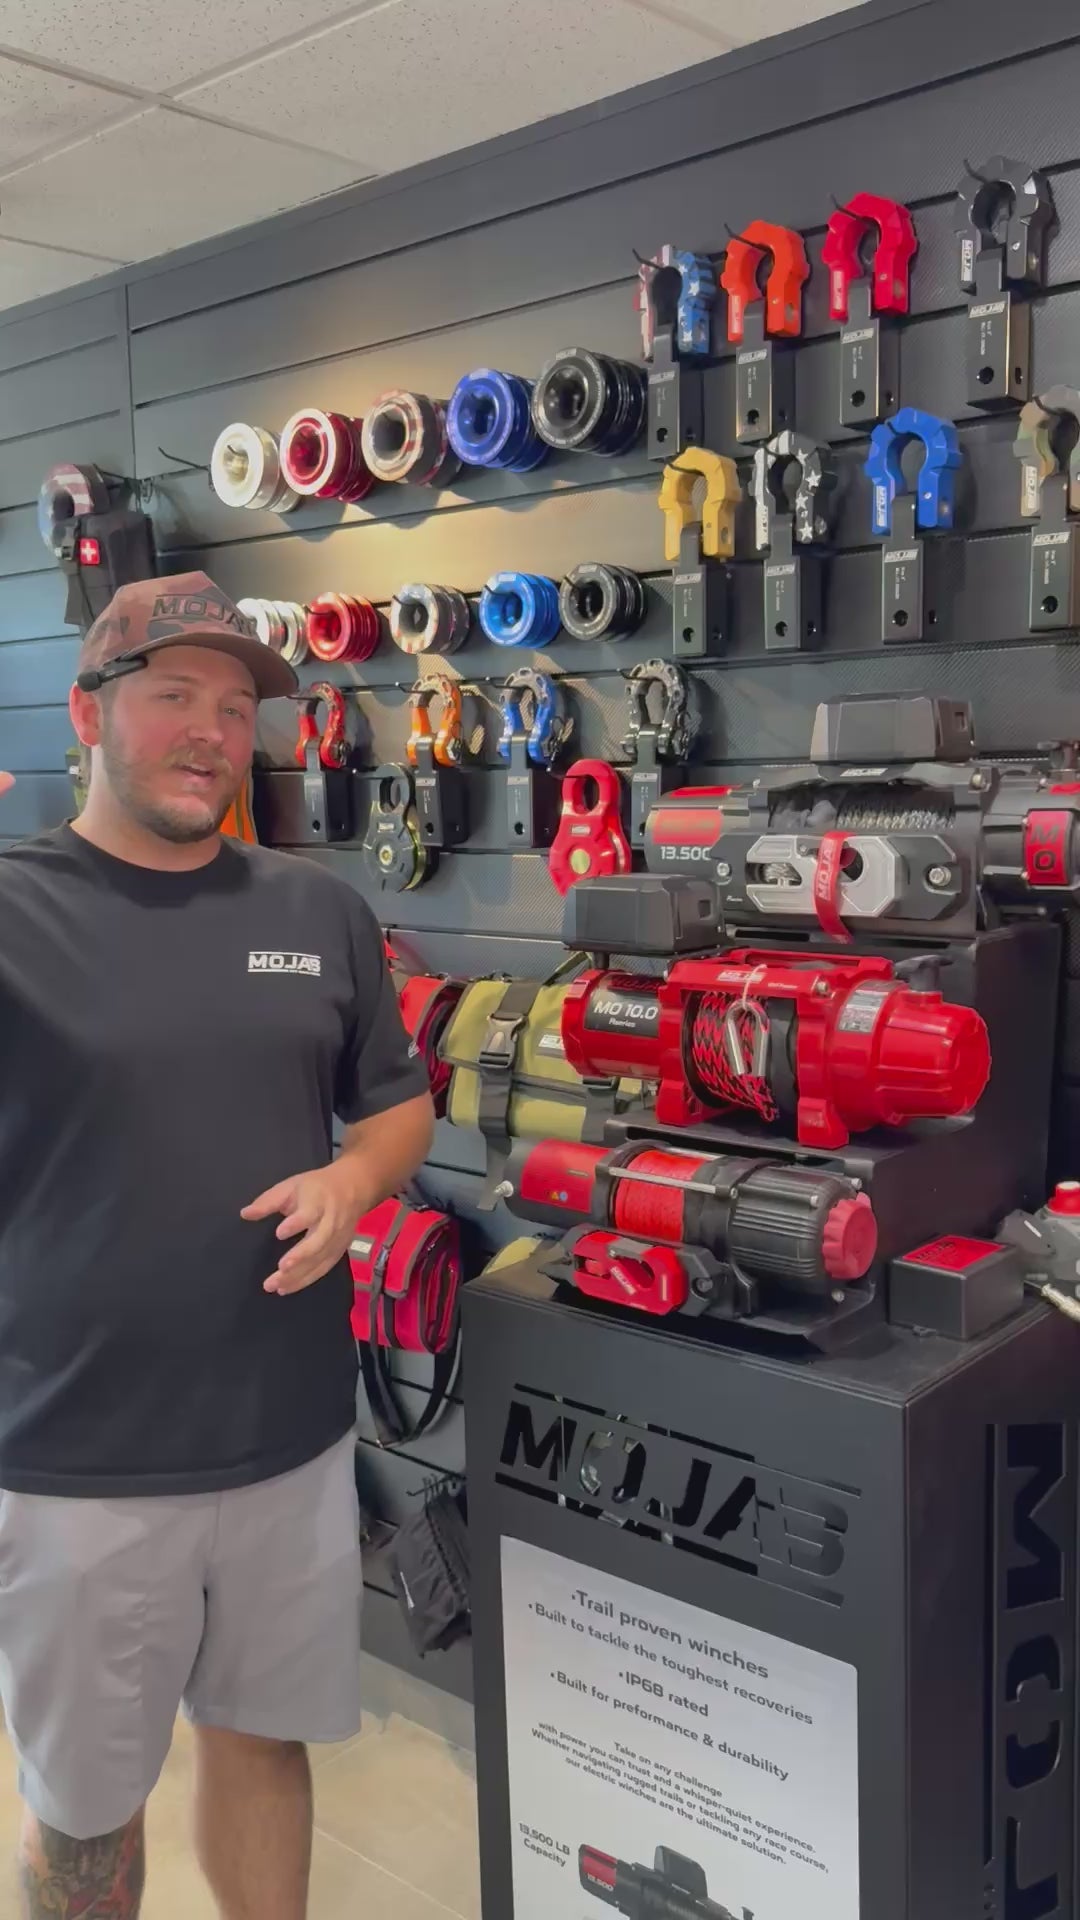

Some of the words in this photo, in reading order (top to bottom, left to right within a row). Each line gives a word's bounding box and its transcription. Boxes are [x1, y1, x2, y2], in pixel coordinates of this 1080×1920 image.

[153, 598, 256, 637] MOJA
[816, 843, 834, 901] MOJA
[249, 954, 322, 972] MOJAB
[594, 1001, 622, 1016] MO
[625, 1004, 659, 1021] 10.0
[500, 1401, 849, 1577] MOJAB
[571, 1617, 585, 1633] to
[588, 1623, 630, 1651] tackle
[634, 1642, 658, 1662] the
[661, 1654, 729, 1691] toughest
[734, 1684, 814, 1725] recoveries
[620, 1609, 682, 1645] proven
[687, 1635, 769, 1679] winches
[669, 1691, 709, 1717] rated
[591, 1685, 610, 1703] for
[613, 1696, 698, 1740] preformance
[703, 1733, 714, 1747] &
[718, 1741, 789, 1782] durability
[538, 1720, 558, 1735] with
[559, 1732, 587, 1750] power
[589, 1743, 607, 1758] you
[608, 1751, 626, 1764] can
[628, 1759, 651, 1778] trust
[653, 1773, 672, 1787] and
[674, 1782, 681, 1791] a
[683, 1786, 753, 1824] whisper-quiet
[614, 1741, 637, 1759] Take
[639, 1754, 652, 1765] on
[654, 1760, 672, 1775] any
[674, 1768, 723, 1798] challenge
[531, 1727, 570, 1753] Whether
[572, 1747, 622, 1778] navigating
[623, 1770, 657, 1794] rugged
[659, 1786, 684, 1806] trails
[686, 1800, 697, 1811] or
[699, 1804, 740, 1833] tackling
[742, 1826, 762, 1842] any
[764, 1837, 787, 1853] race
[789, 1848, 829, 1874] course,
[565, 1755, 581, 1769] our
[583, 1763, 616, 1785] electric
[618, 1778, 657, 1804] winches
[659, 1799, 675, 1811] are
[676, 1805, 694, 1821] the
[696, 1816, 739, 1842] ultimate
[741, 1837, 787, 1865] solution.
[523, 1837, 567, 1867] Capacity
[555, 1841, 571, 1856] LB
